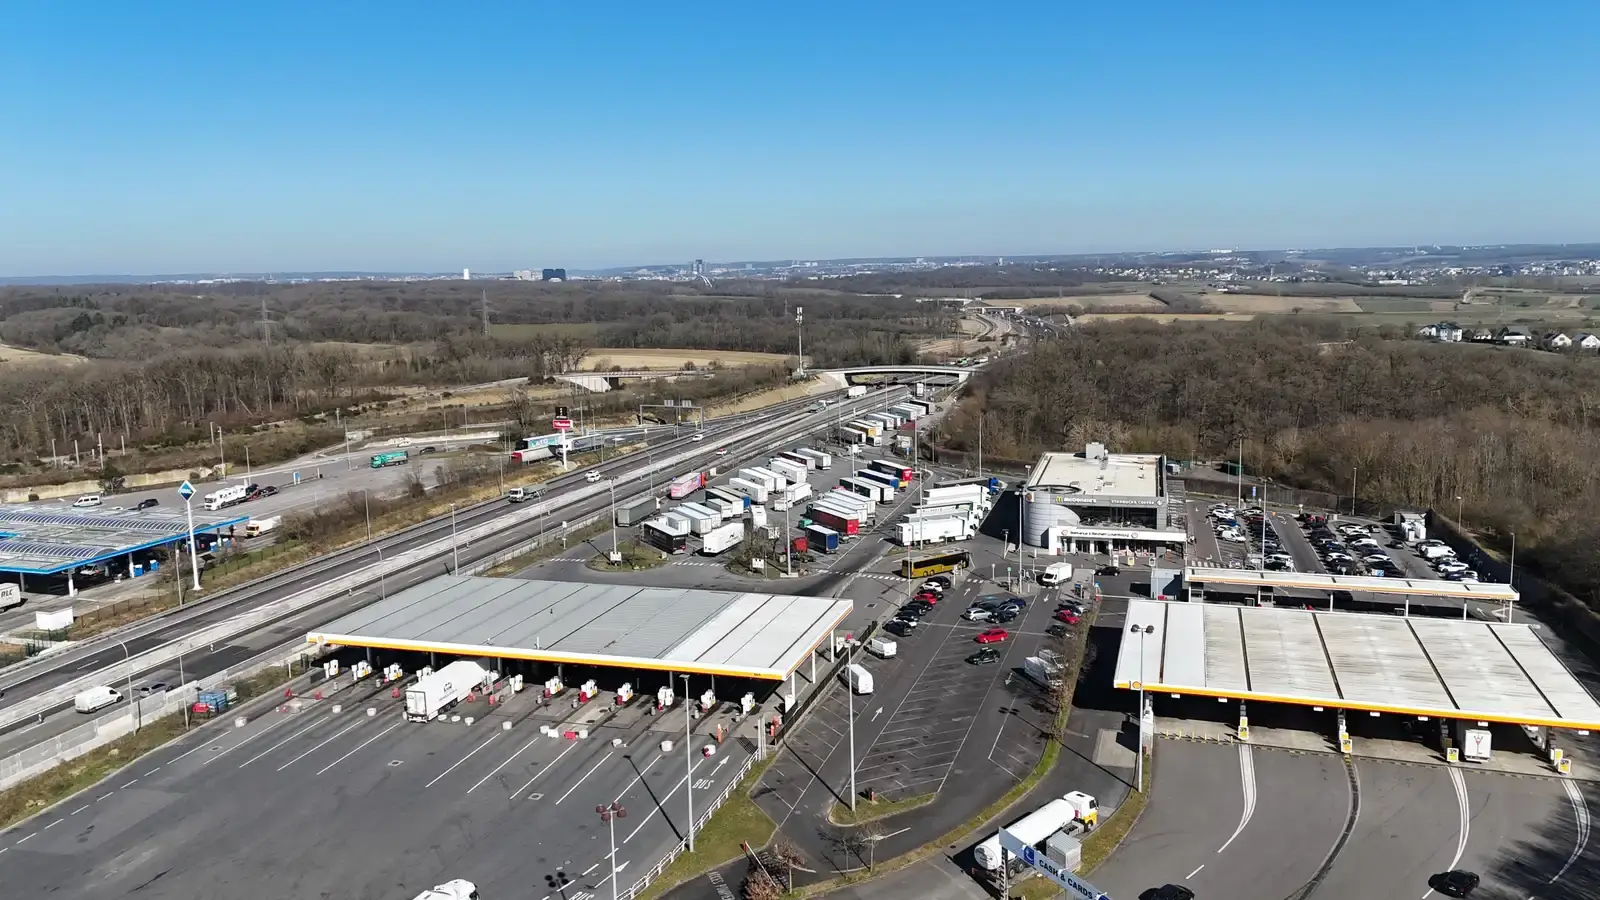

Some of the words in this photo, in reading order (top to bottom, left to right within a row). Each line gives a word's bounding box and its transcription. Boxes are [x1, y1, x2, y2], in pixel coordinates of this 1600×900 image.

[692, 779, 715, 789] BUS
[1038, 859, 1059, 877] CASH
[1060, 873, 1066, 882] &
[1067, 878, 1093, 900] CARDS
